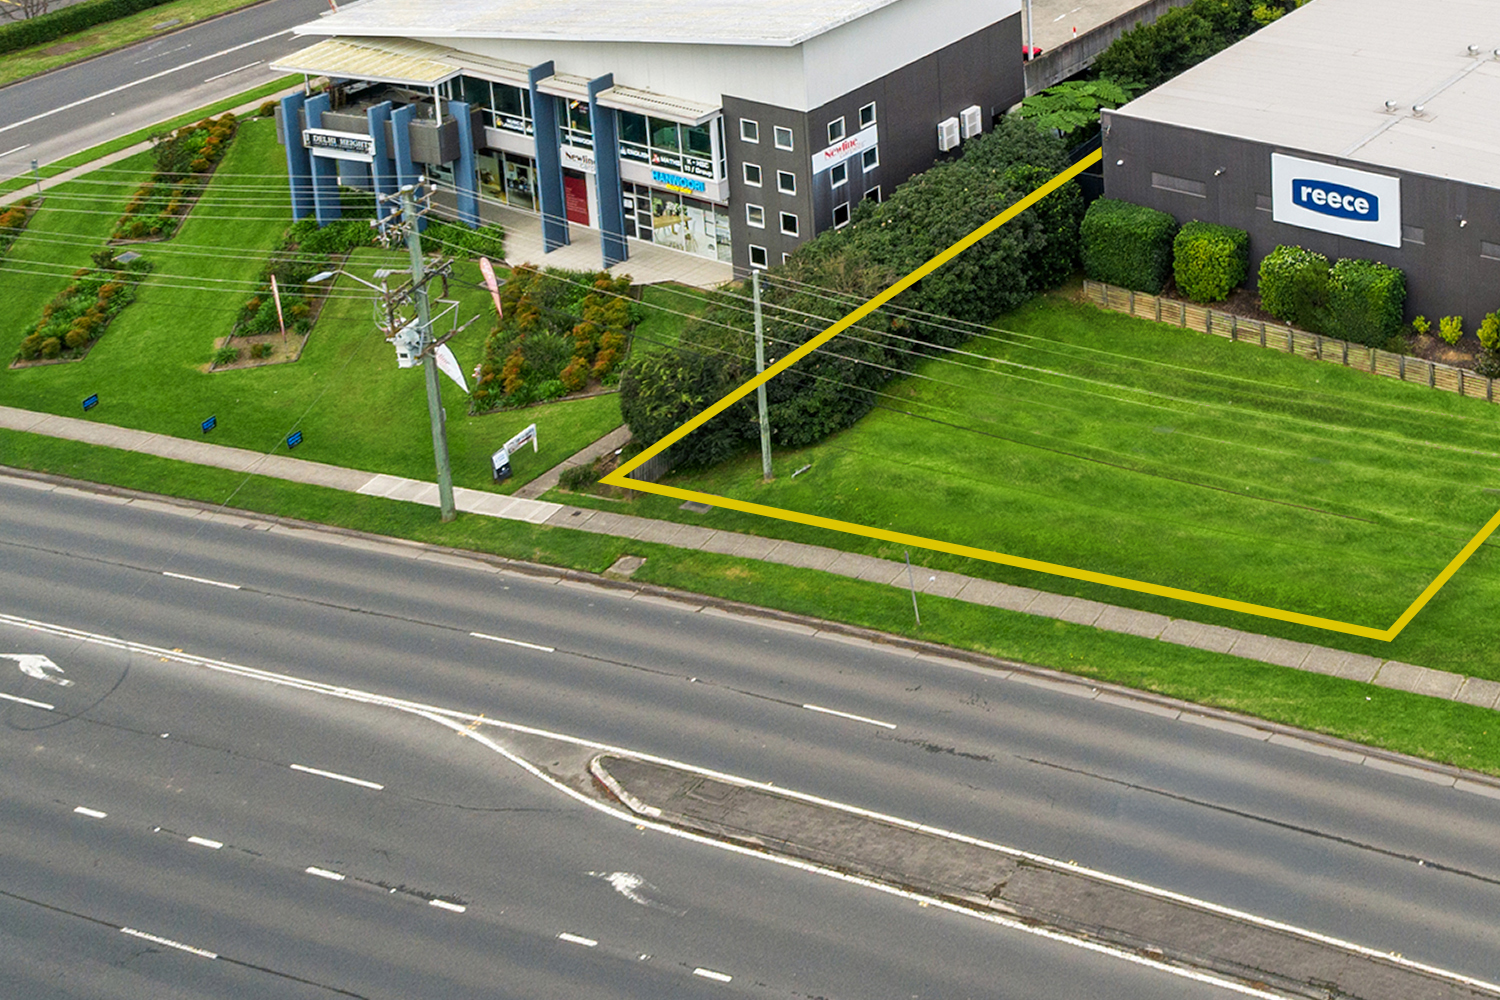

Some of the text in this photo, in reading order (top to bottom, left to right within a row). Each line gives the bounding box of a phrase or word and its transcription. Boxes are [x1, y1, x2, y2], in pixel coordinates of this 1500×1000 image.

[313, 135, 337, 144] DELHI
[824, 139, 858, 159] Newline
[1301, 185, 1370, 215] reece
